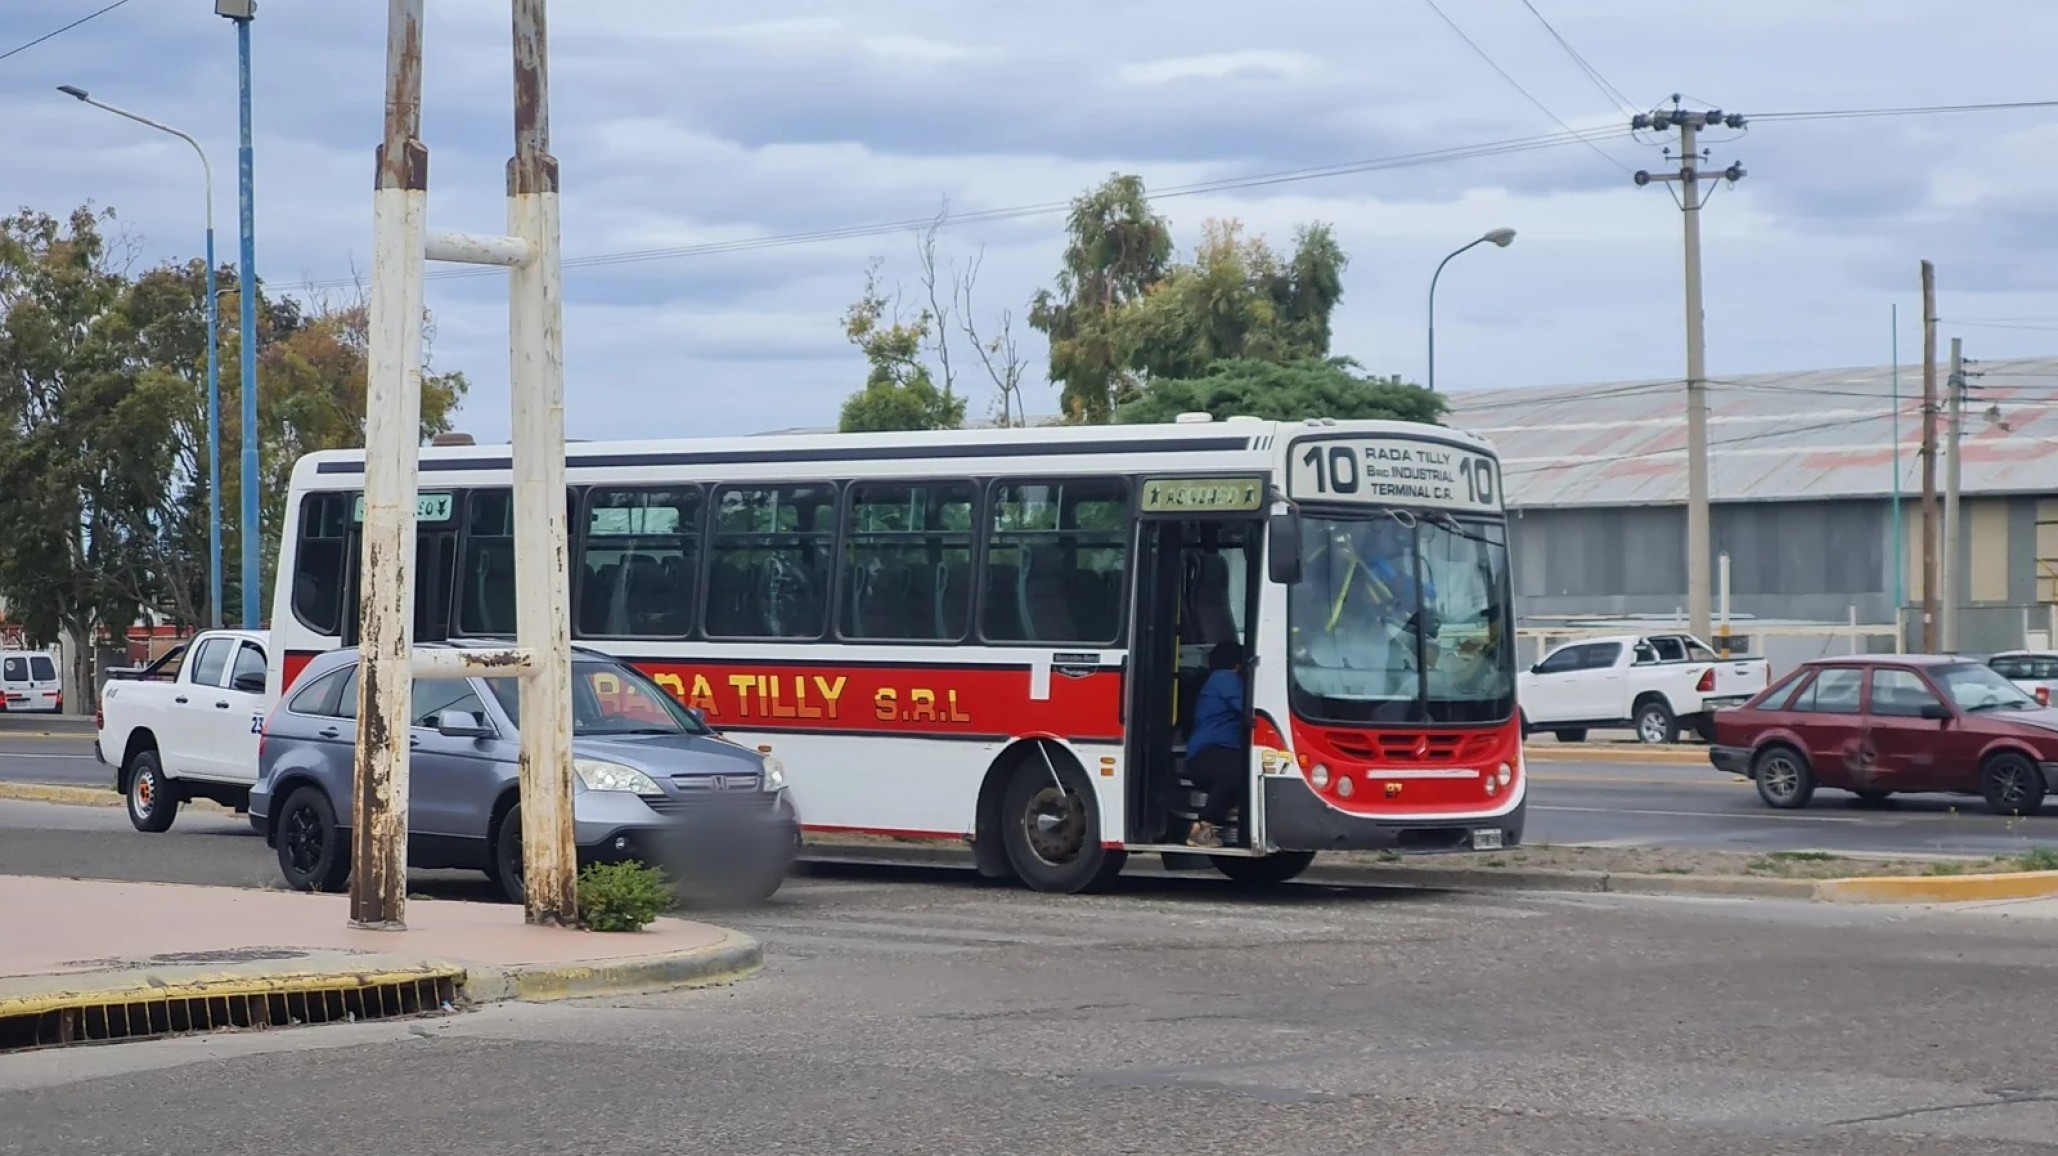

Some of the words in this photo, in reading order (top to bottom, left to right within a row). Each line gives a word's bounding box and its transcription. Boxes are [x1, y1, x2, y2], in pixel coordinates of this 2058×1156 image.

[1303, 446, 1359, 494] 10
[1365, 447, 1413, 462] RADA
[1416, 450, 1451, 465] TILLY
[1371, 482, 1431, 499] TERMINAL
[1459, 456, 1493, 505] 10
[728, 674, 847, 719] TILLY
[874, 687, 971, 722] S.R.L
